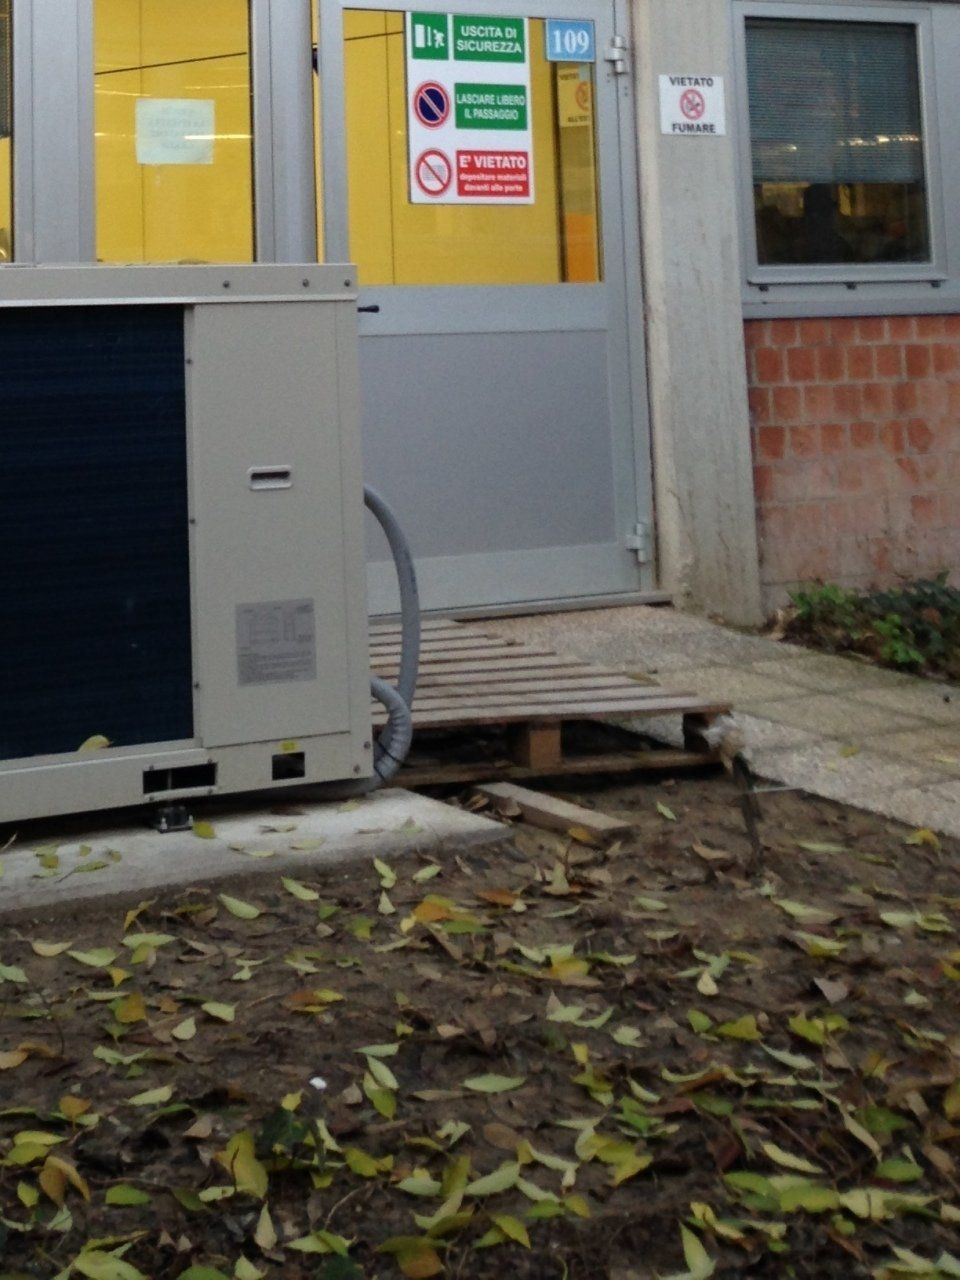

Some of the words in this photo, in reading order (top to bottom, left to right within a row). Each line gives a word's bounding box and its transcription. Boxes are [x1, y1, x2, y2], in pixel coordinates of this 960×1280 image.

[461, 25, 503, 38] USCITA
[505, 27, 517, 39] DI
[457, 39, 522, 53] SICUREZZA
[553, 29, 589, 54] 109
[669, 76, 714, 87] VIETATO
[456, 93, 495, 105] LASCIARE
[497, 94, 525, 106] LIBERO
[464, 108, 472, 119] IL
[473, 108, 519, 120] PASSAGGIO
[672, 123, 716, 134] FUMARE
[474, 156, 527, 169] VIETATO
